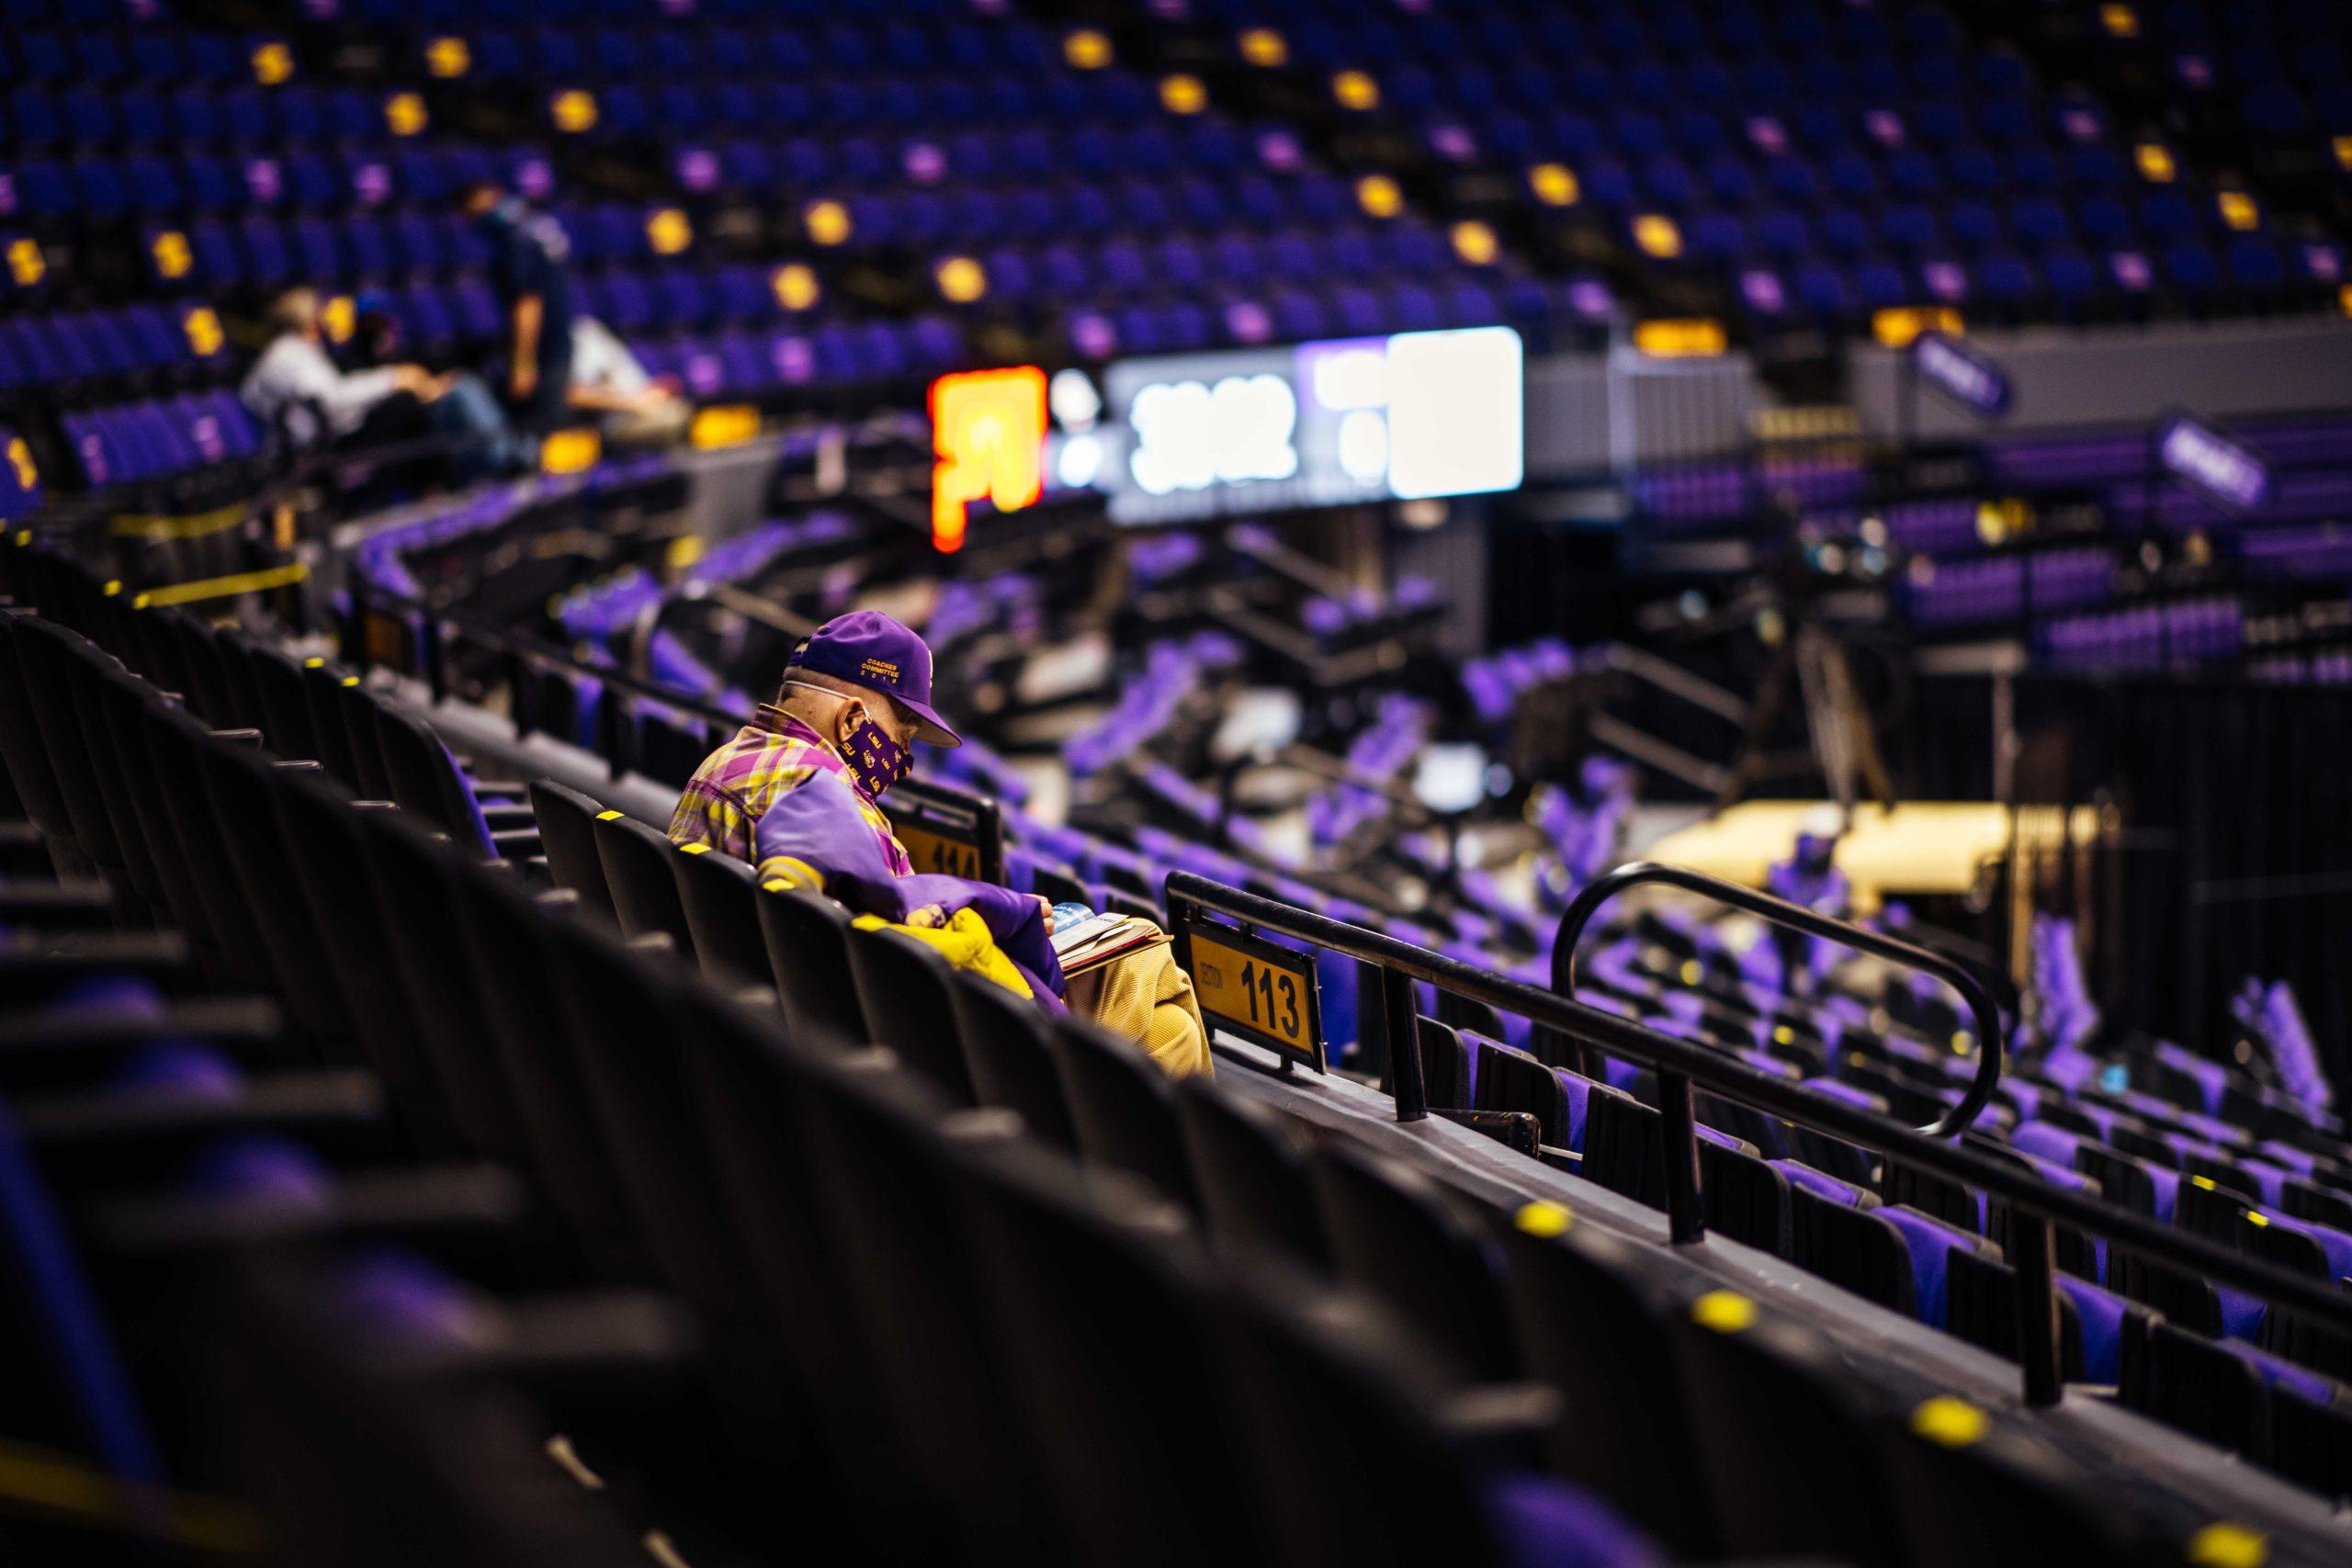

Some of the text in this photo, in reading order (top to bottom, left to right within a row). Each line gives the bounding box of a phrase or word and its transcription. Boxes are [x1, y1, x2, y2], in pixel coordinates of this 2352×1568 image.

[861, 662, 900, 678] COMMITTEE
[866, 658, 898, 671] COACHES
[867, 731, 882, 750] LSU
[1241, 960, 1300, 1039] 113
